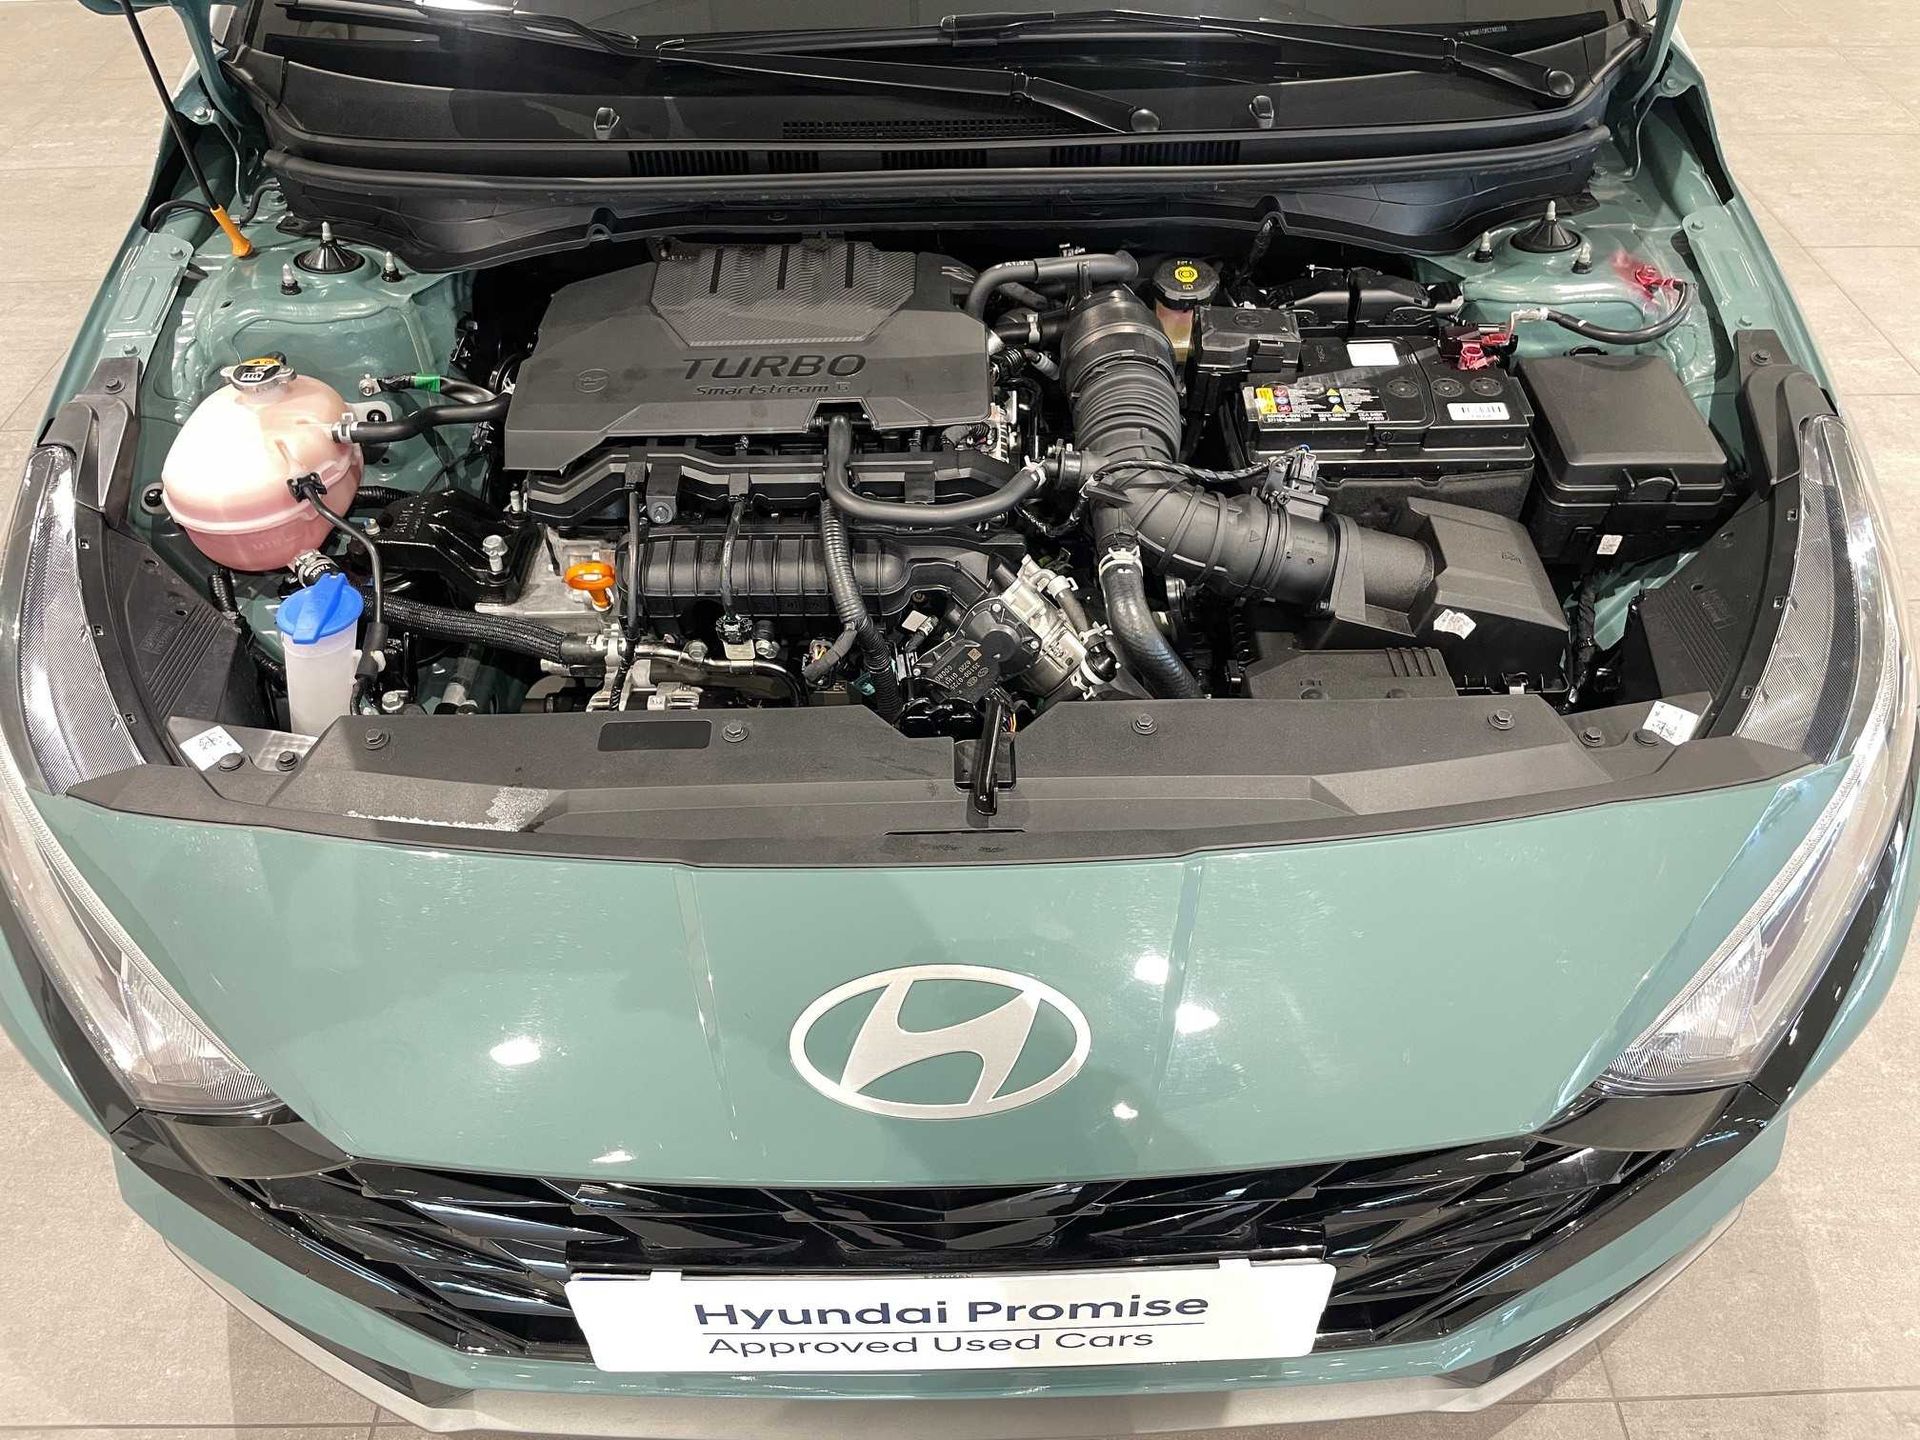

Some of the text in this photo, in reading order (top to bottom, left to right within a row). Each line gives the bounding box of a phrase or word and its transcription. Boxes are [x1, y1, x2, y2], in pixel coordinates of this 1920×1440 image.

[682, 354, 867, 380] TURBO
[695, 382, 829, 396] Smartstream
[693, 1294, 1209, 1330] Hyundai Promise
[708, 1330, 1154, 1358] Approved Used Cars
